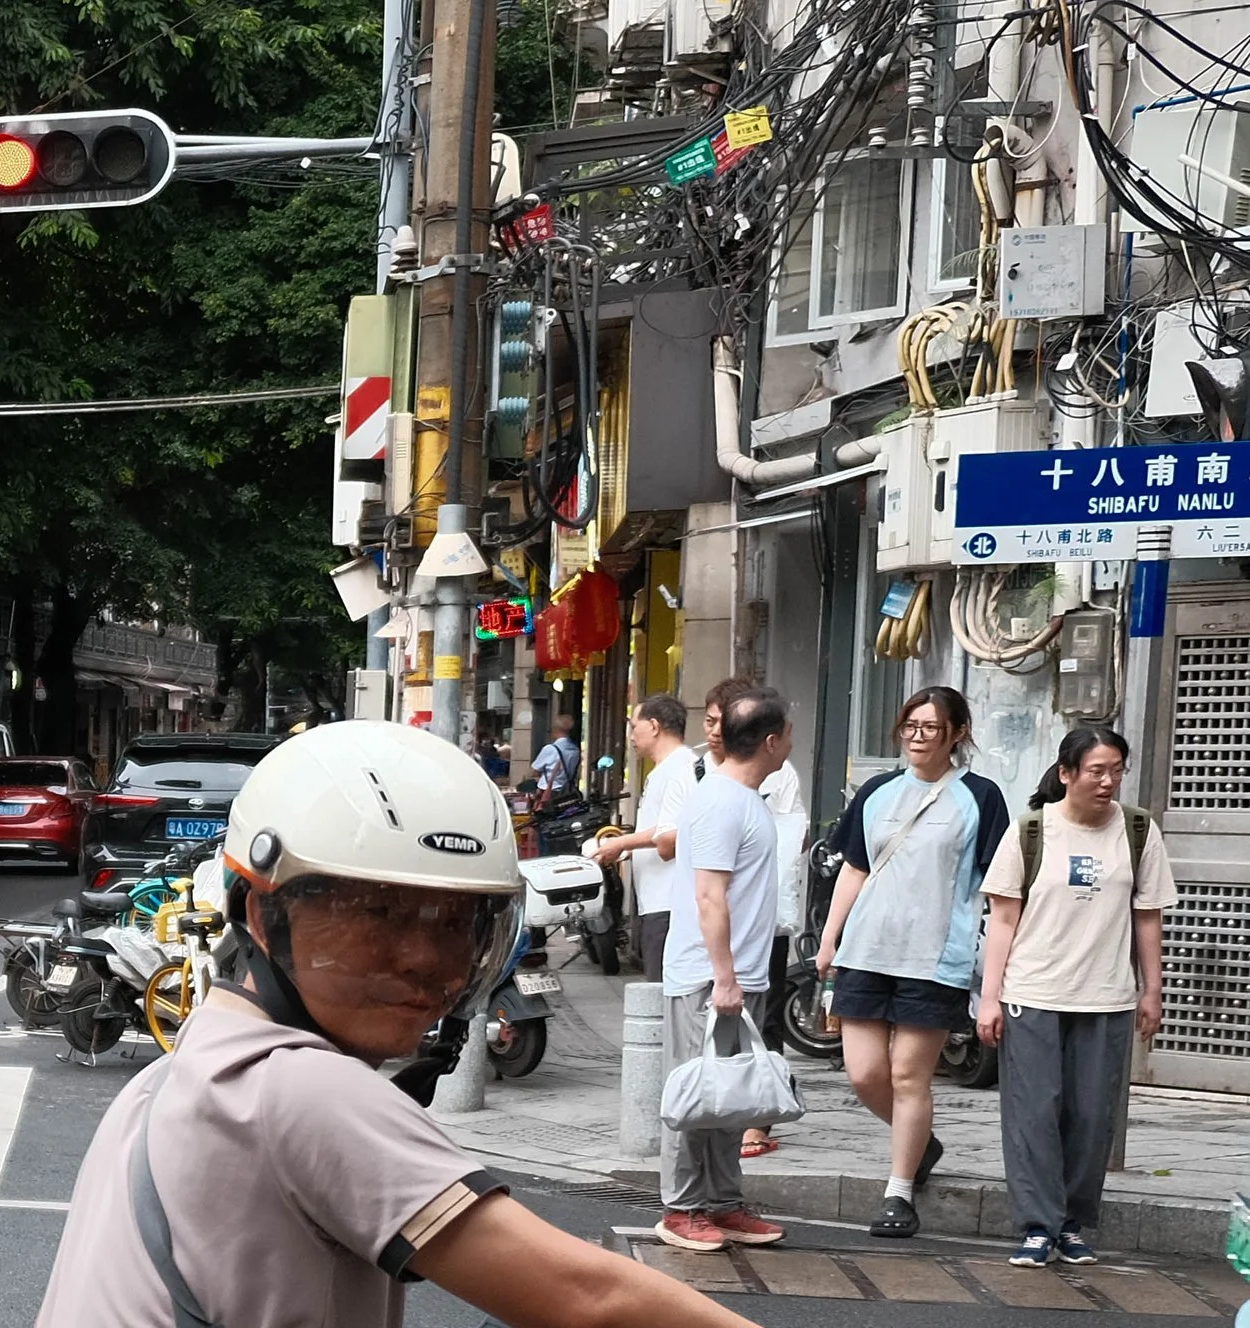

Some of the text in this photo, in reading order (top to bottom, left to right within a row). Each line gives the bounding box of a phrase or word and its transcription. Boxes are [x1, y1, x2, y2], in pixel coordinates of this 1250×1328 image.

[1088, 492, 1234, 514] SHIBAFU NANLU
[973, 536, 992, 555] 北
[1016, 528, 1113, 545] 十八甫北路
[1027, 548, 1093, 558] SHIBAFU BEILU
[481, 606, 526, 630] 地产
[433, 835, 477, 852] YEMA
